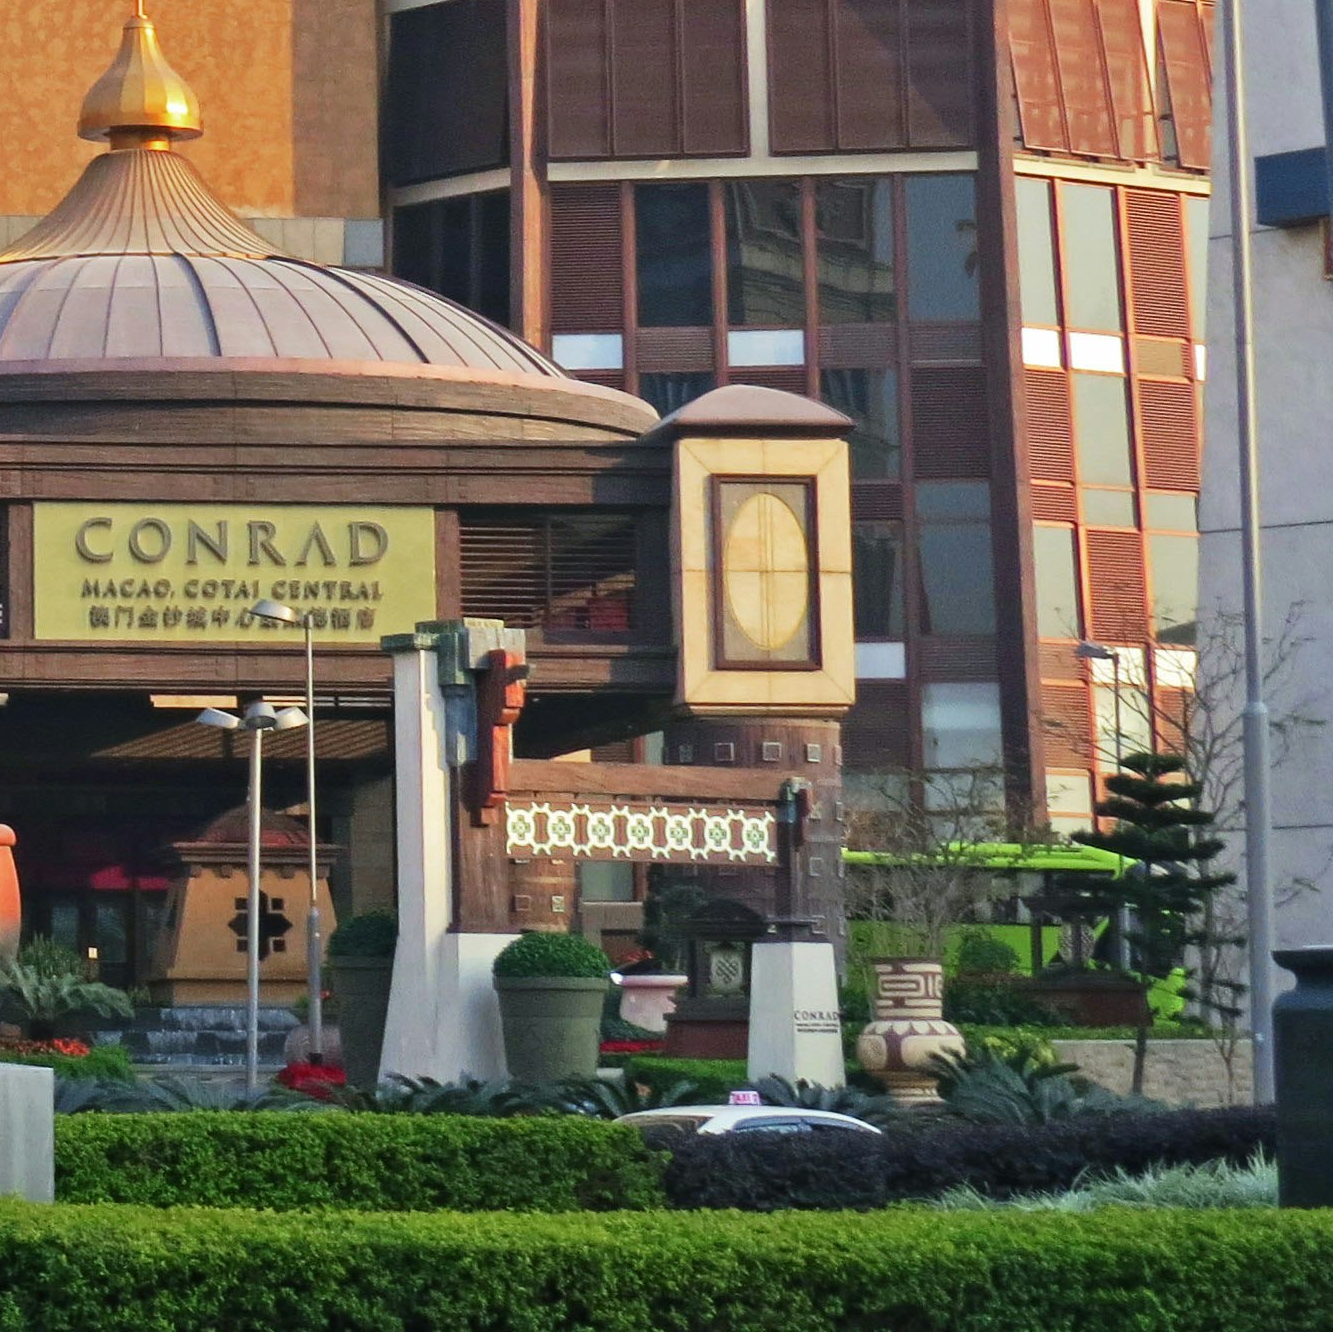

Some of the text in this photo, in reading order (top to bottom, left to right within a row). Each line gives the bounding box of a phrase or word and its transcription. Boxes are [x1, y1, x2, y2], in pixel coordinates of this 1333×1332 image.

[75, 517, 389, 567] CONRAD
[184, 579, 259, 600] COTAI
[271, 579, 383, 601] CENTRAL
[794, 1010, 840, 1021] CONRAD
